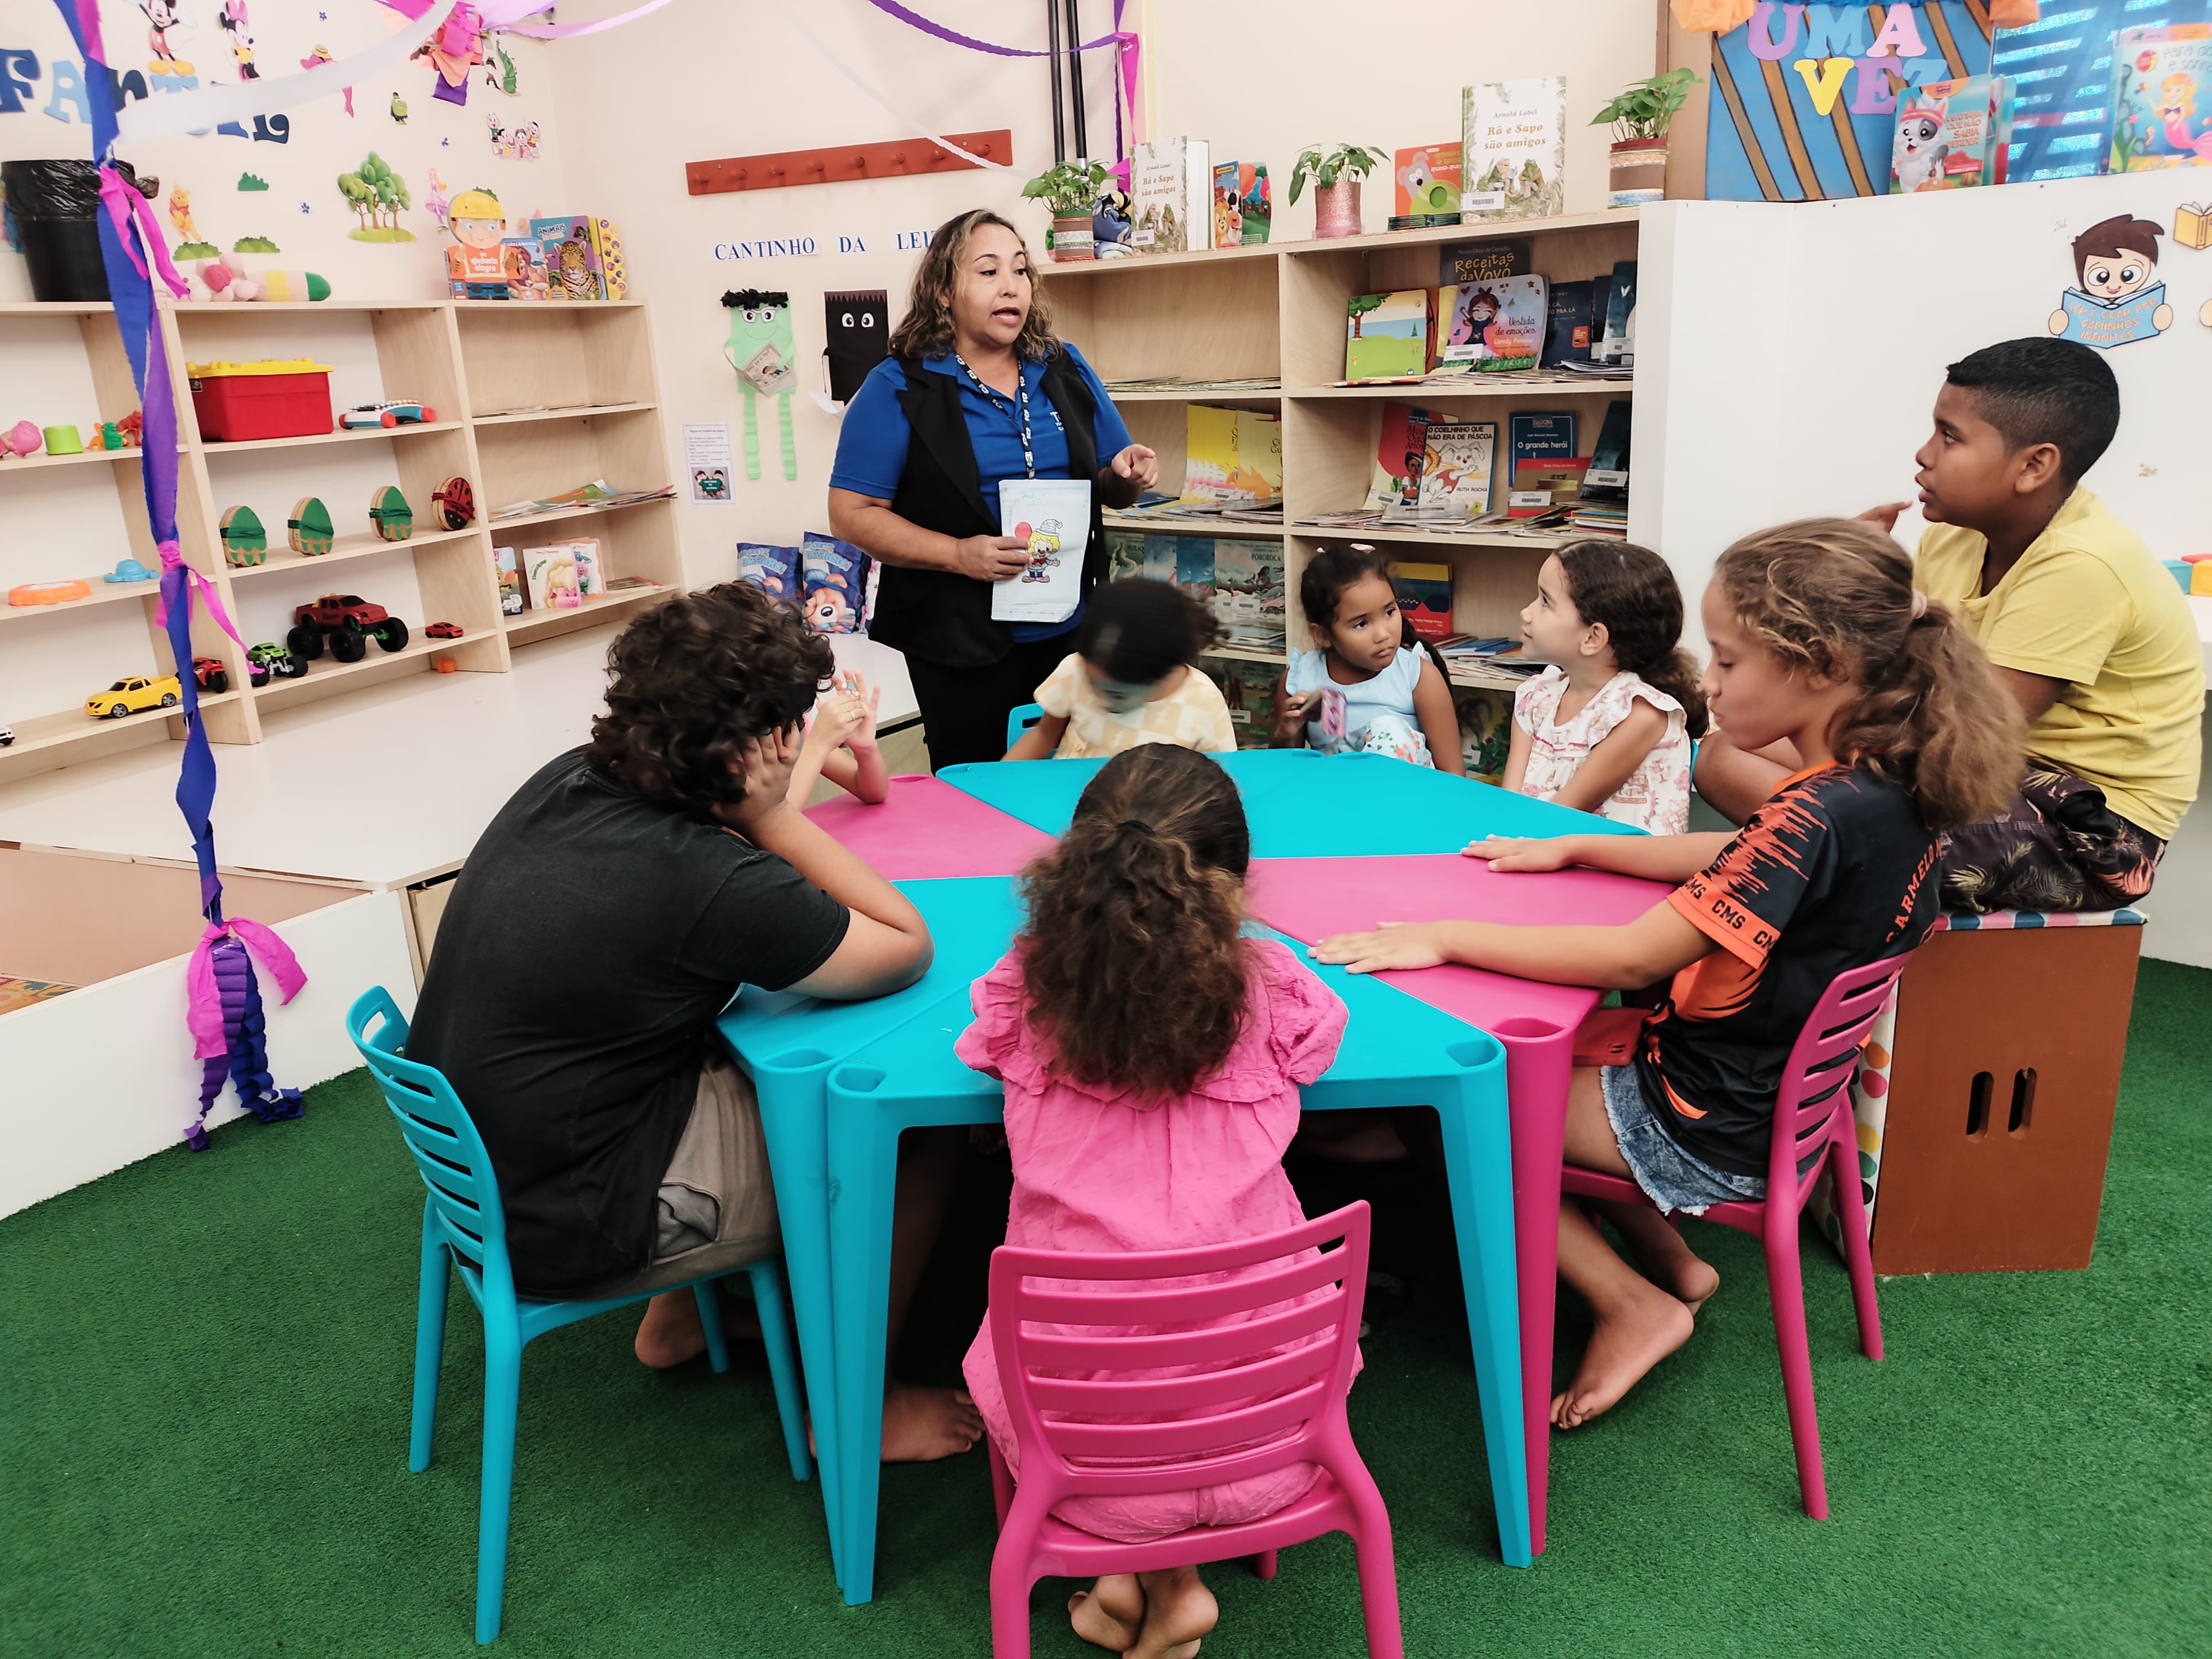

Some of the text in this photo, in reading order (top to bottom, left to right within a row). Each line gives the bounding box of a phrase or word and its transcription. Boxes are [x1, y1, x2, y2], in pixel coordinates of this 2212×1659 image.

[1748, 3, 1927, 60] UMA
[1951, 112, 1982, 121] GATINHA
[1488, 126, 1502, 135] Rã
[1515, 124, 1543, 133] Sapo
[1947, 119, 1981, 130] QUE NÃO
[1953, 128, 1979, 138] SABIA
[1484, 137, 1546, 149] são amigos
[1947, 138, 1979, 148] PERDER
[538, 223, 566, 235] ANIMAIS
[714, 236, 815, 260] CANTINHO
[838, 236, 866, 253] DA
[1455, 253, 1515, 273] Receitas
[1460, 262, 1511, 281] da Vovó
[2067, 298, 2157, 319] LER É VOAR POR
[1509, 316, 1535, 326] Vestida
[2081, 317, 2138, 330] CAMINHOS
[1506, 326, 1536, 336] emoções
[1525, 441, 1549, 450] grande
[1251, 553, 1281, 562] POROROCA
[1712, 899, 1746, 930] CMS
[1753, 930, 1775, 949] CM
